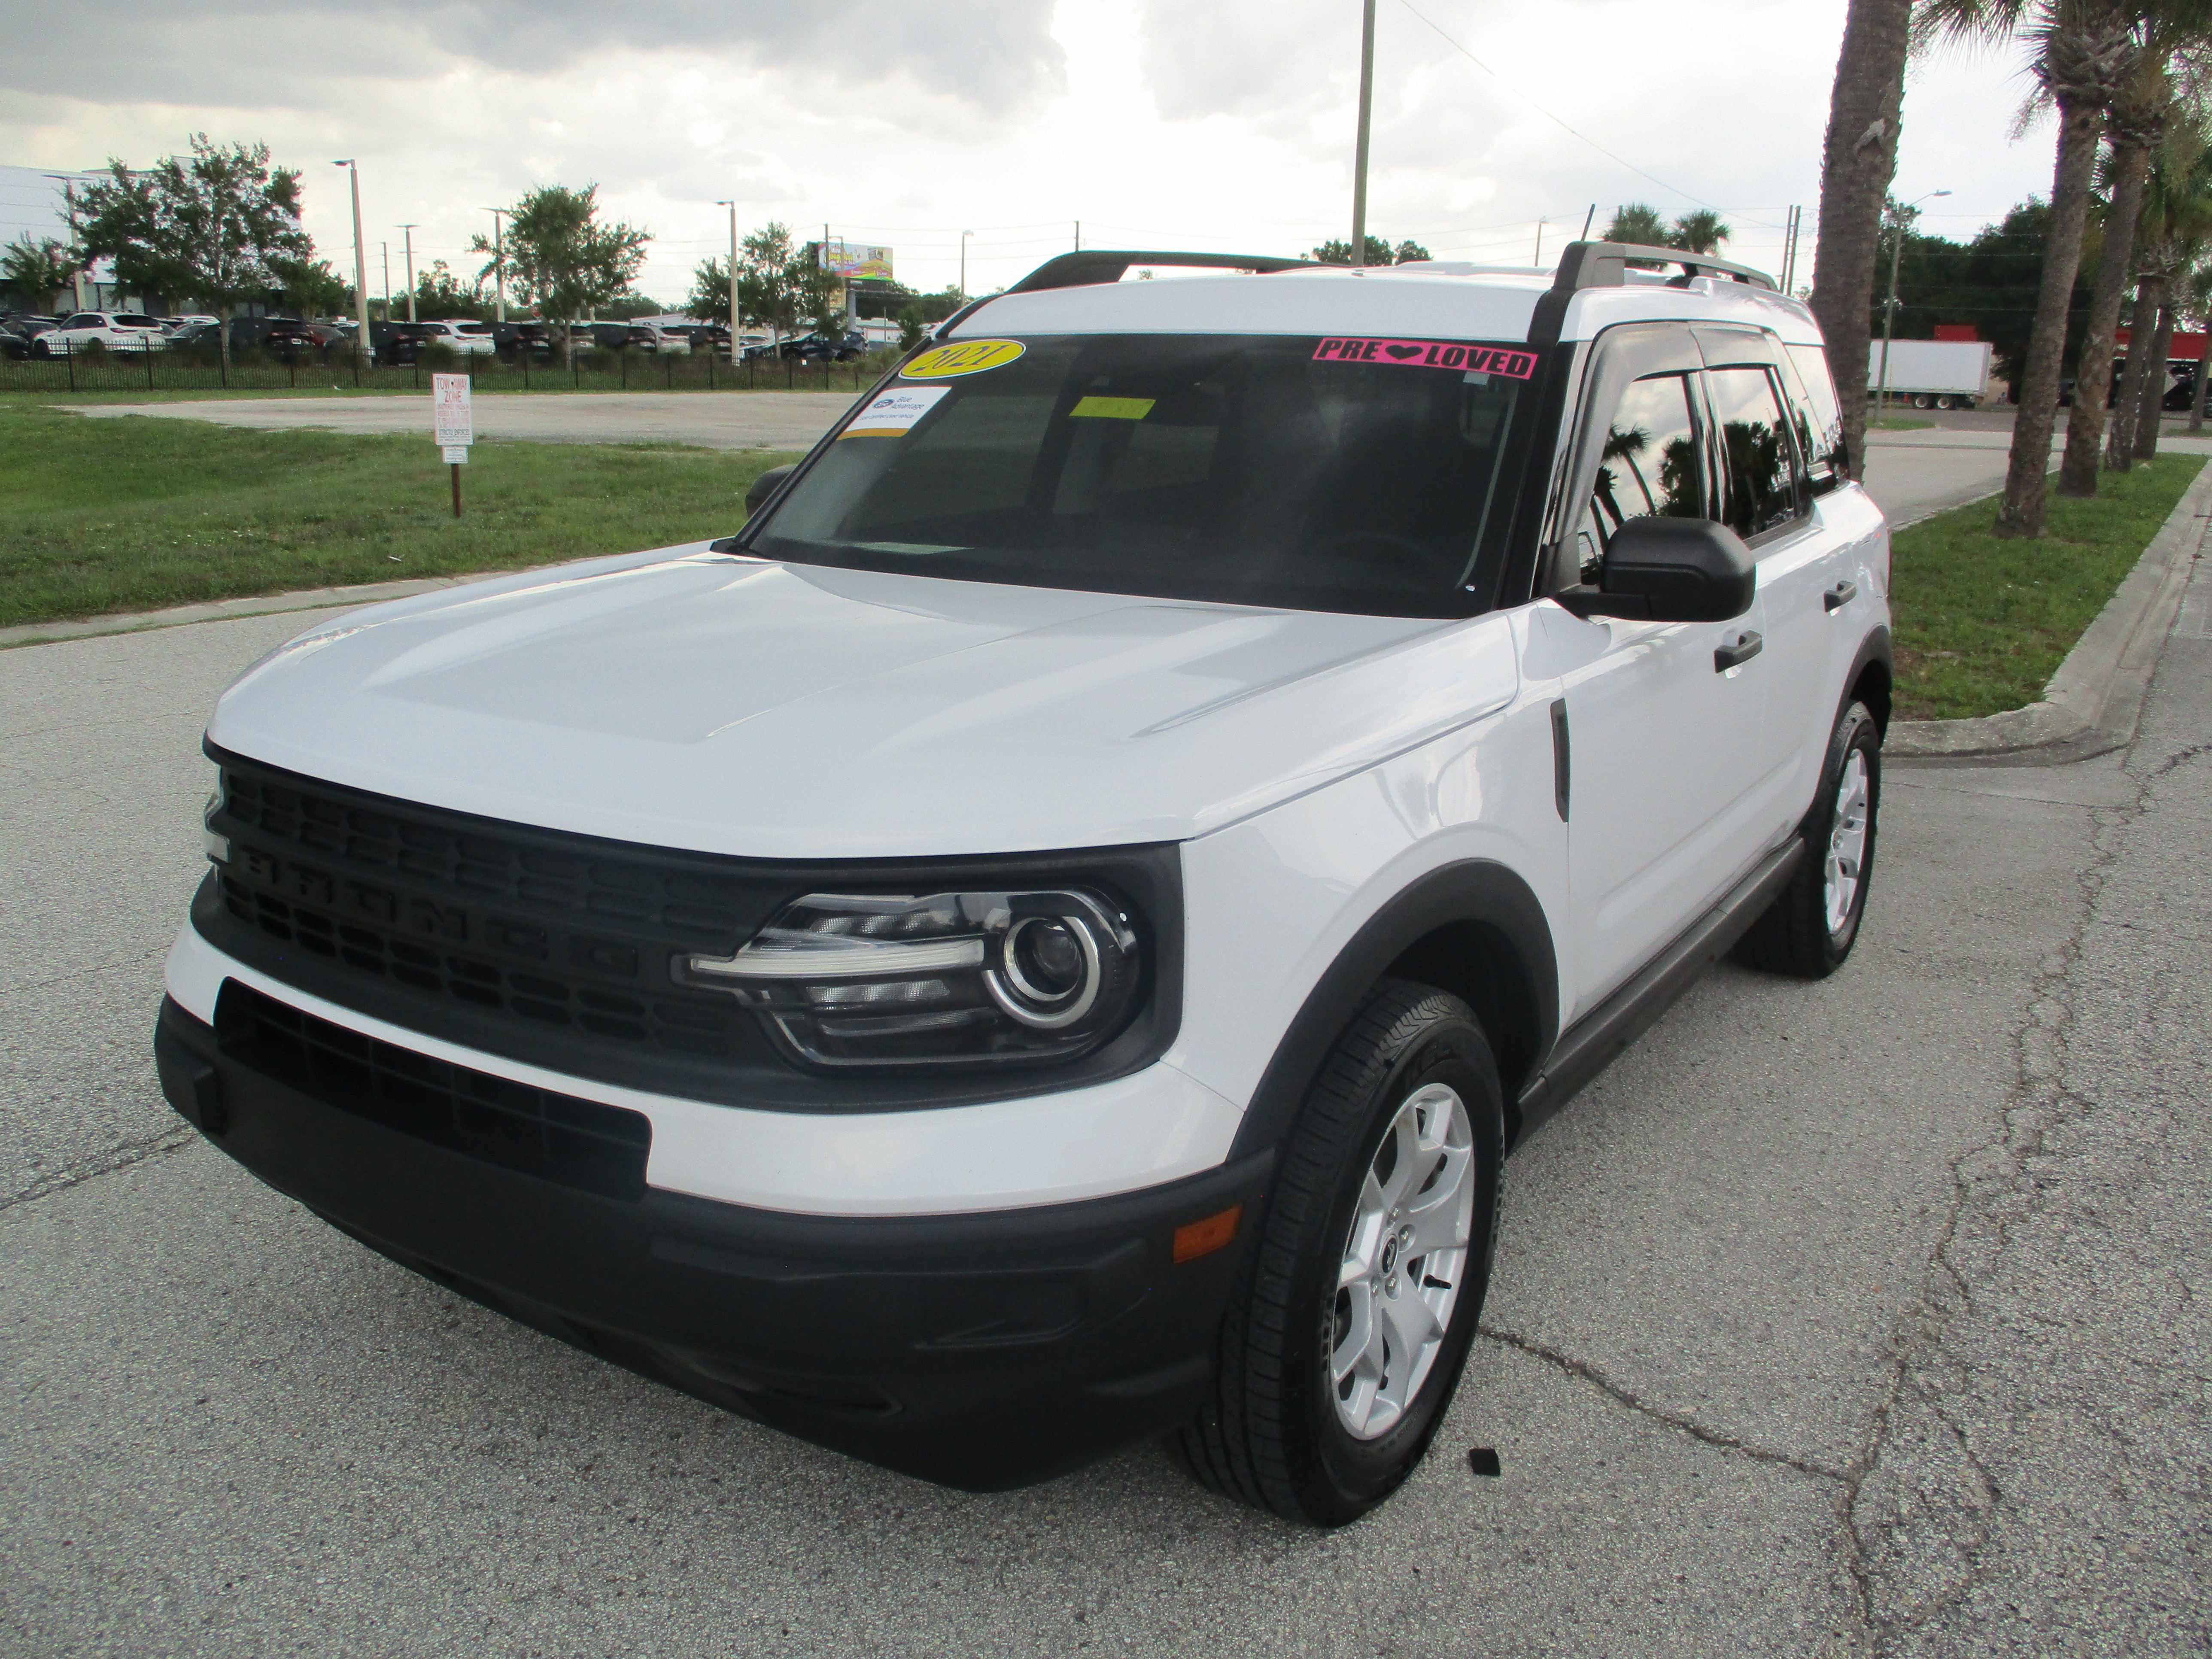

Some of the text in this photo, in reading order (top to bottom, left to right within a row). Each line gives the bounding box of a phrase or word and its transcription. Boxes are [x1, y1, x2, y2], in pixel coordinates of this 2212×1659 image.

[911, 344, 1010, 372] 2021
[1317, 339, 1532, 376] PRE LOVED
[444, 390, 462, 403] ZONE
[234, 842, 641, 980] BRONCO
